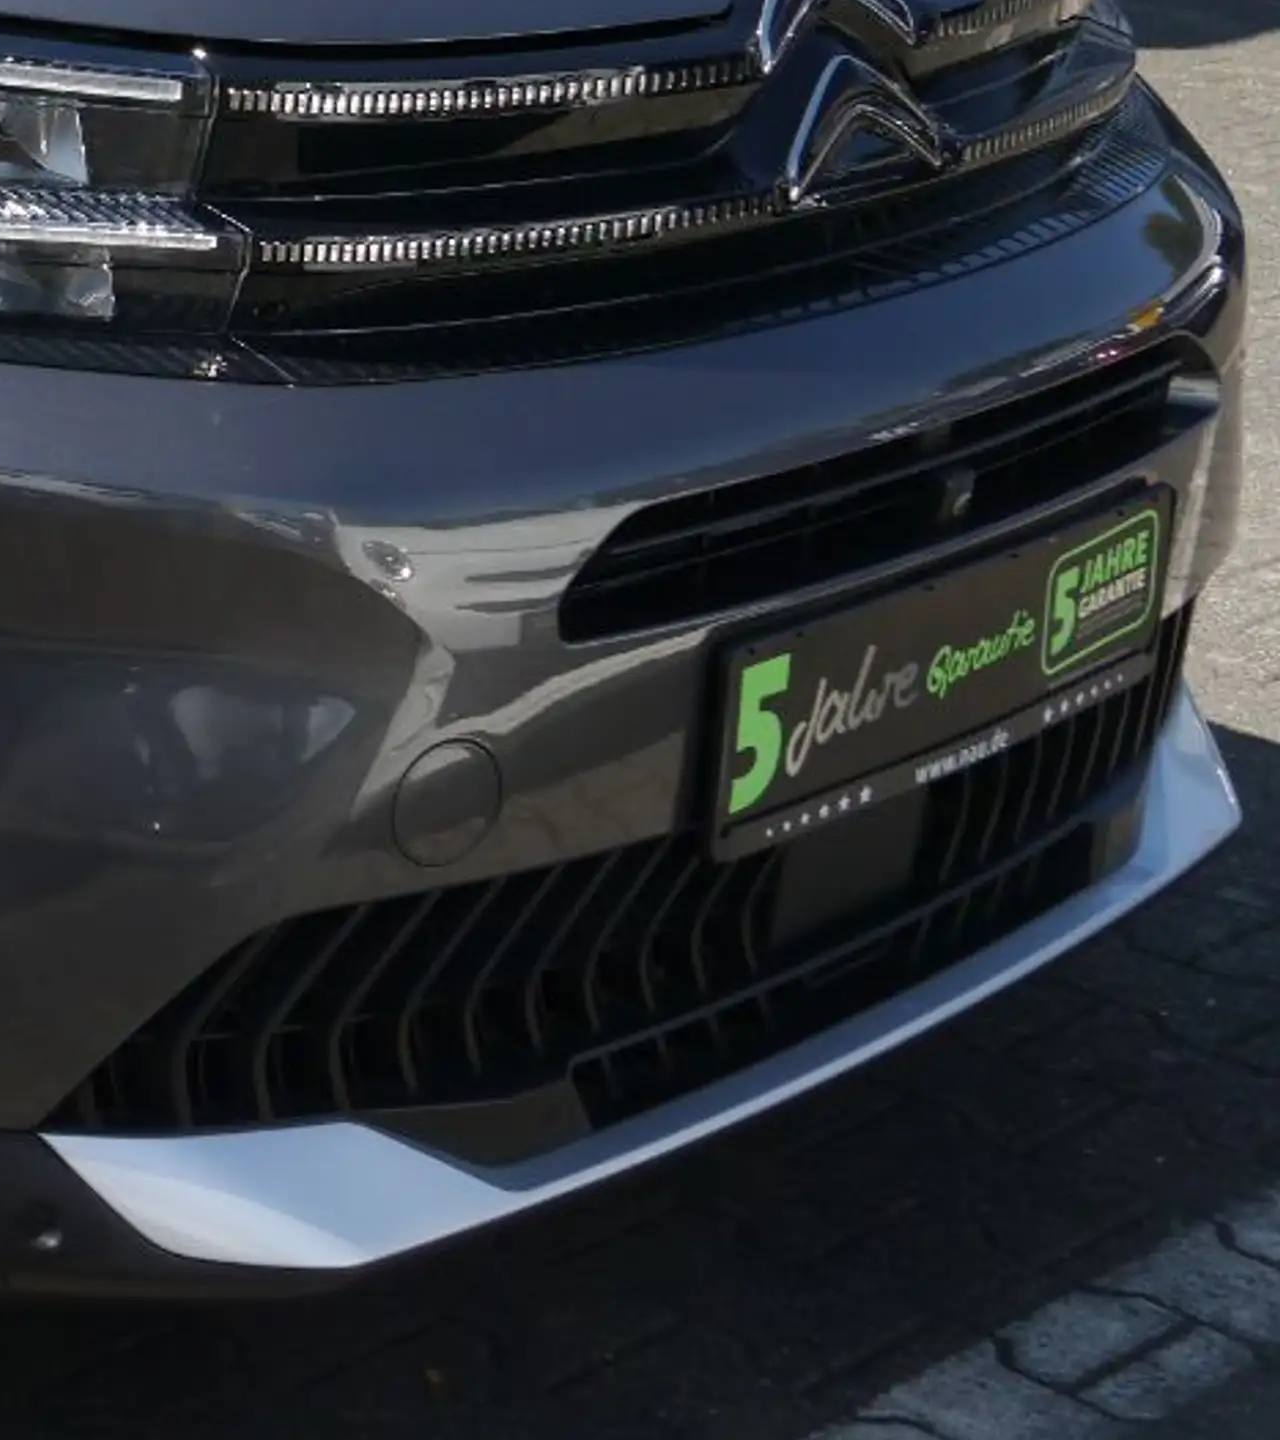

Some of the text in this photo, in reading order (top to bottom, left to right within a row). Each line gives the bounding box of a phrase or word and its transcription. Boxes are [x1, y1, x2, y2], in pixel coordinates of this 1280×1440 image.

[1050, 565, 1080, 657] 5
[1078, 529, 1151, 594] JAHRE
[729, 653, 791, 815] 5
[785, 644, 919, 778] Jahre
